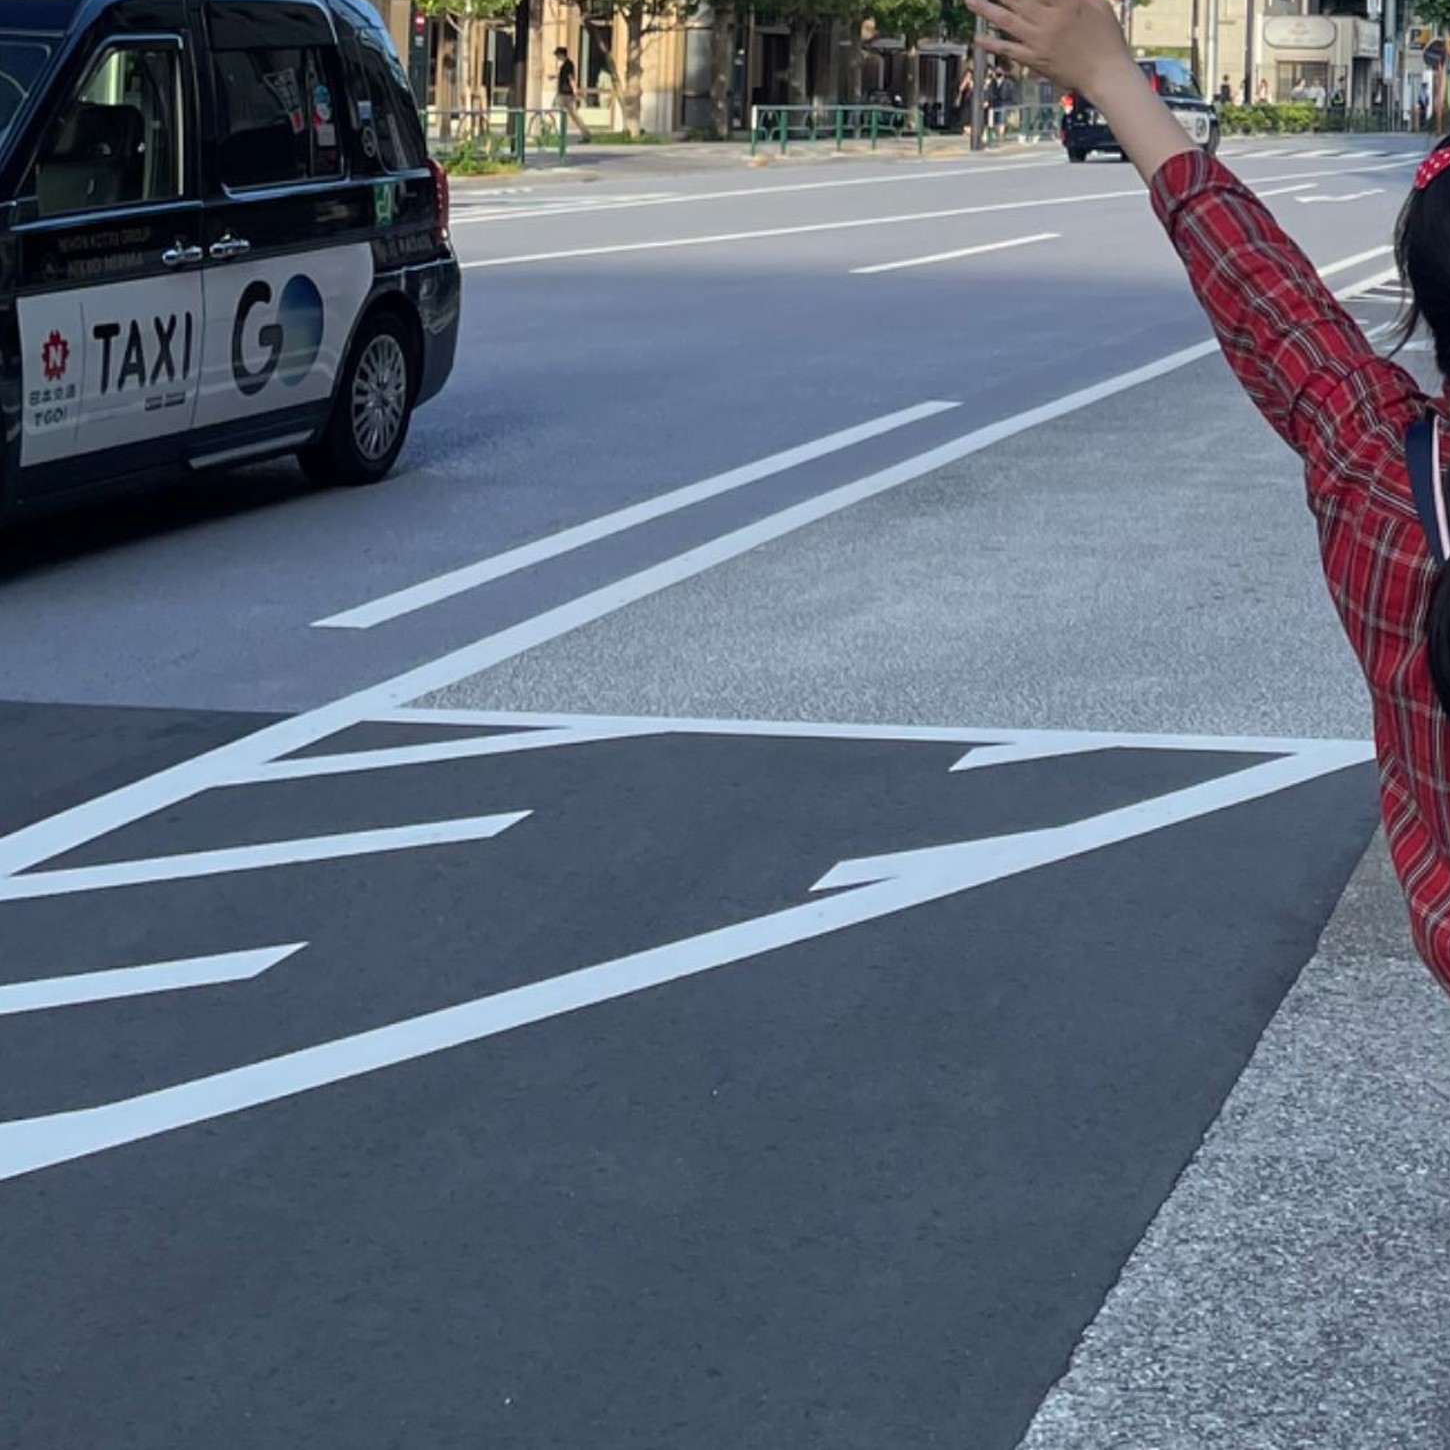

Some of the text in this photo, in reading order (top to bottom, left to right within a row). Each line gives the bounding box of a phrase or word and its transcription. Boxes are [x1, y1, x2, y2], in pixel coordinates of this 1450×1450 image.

[93, 311, 192, 394] TAXI
[232, 274, 324, 396] GO
[29, 384, 76, 406] 日本交通
